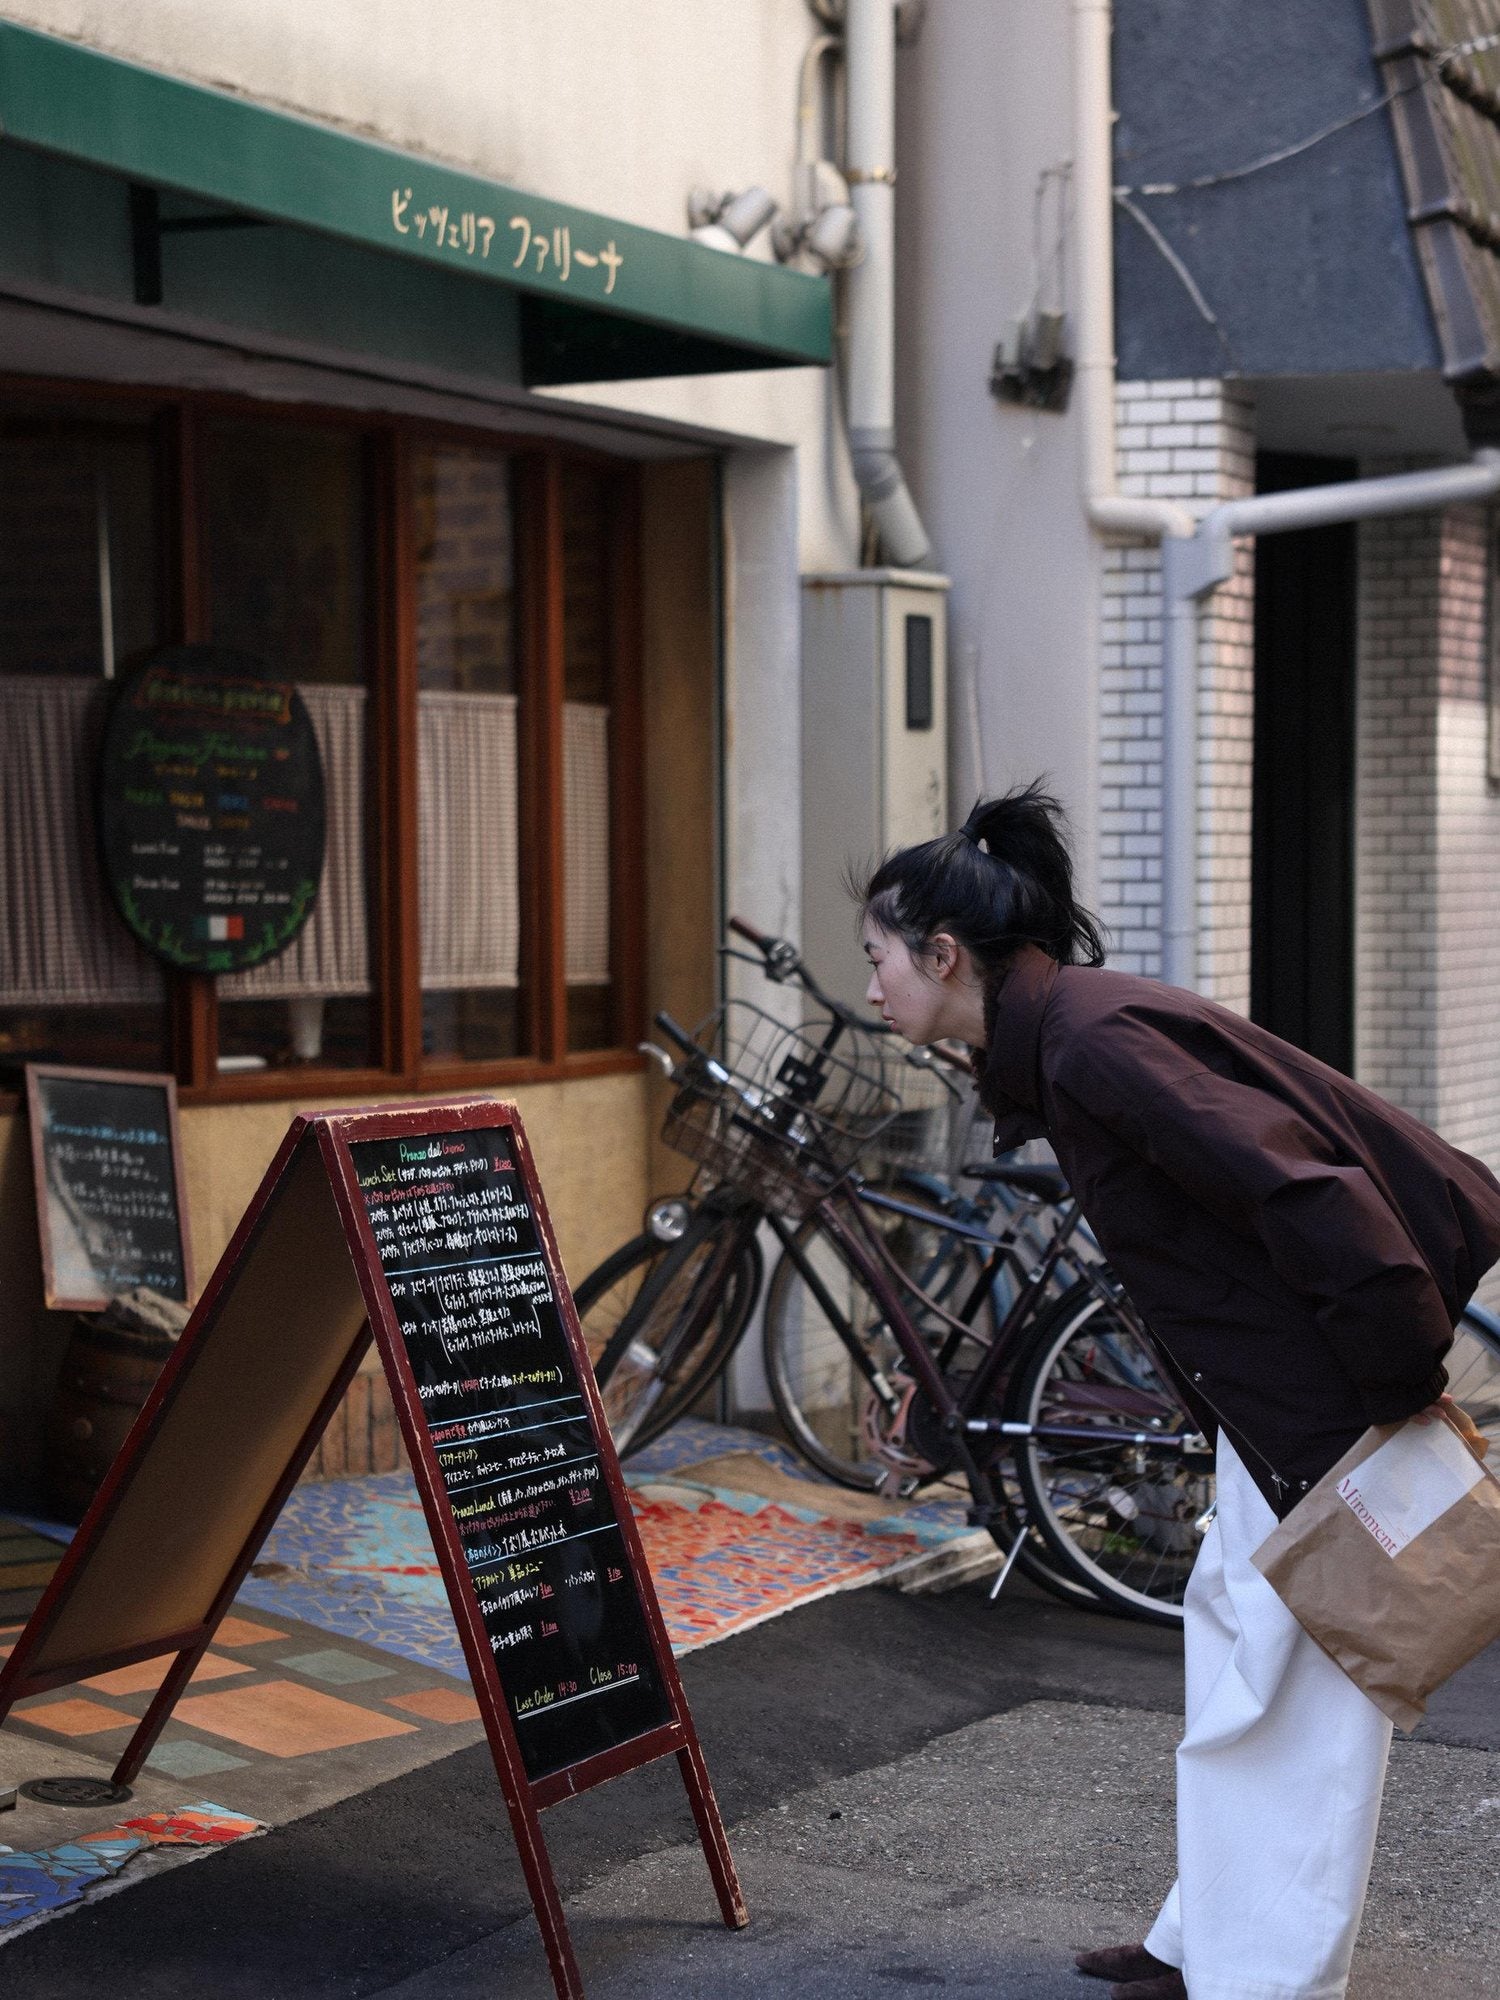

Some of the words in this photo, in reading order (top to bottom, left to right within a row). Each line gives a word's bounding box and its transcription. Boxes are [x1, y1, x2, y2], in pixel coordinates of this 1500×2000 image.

[391, 187, 496, 258] ピッツェリア
[508, 215, 625, 295] ファリーナ
[427, 1142, 442, 1158] del
[356, 1171, 381, 1186] Lunch
[381, 1165, 396, 1182] Set
[474, 1496, 496, 1513] Lunch
[514, 1692, 533, 1712] Last
[535, 1687, 554, 1705] Order
[557, 1681, 577, 1695] 14:30
[590, 1668, 612, 1684] Close
[615, 1664, 637, 1676] 15:00
